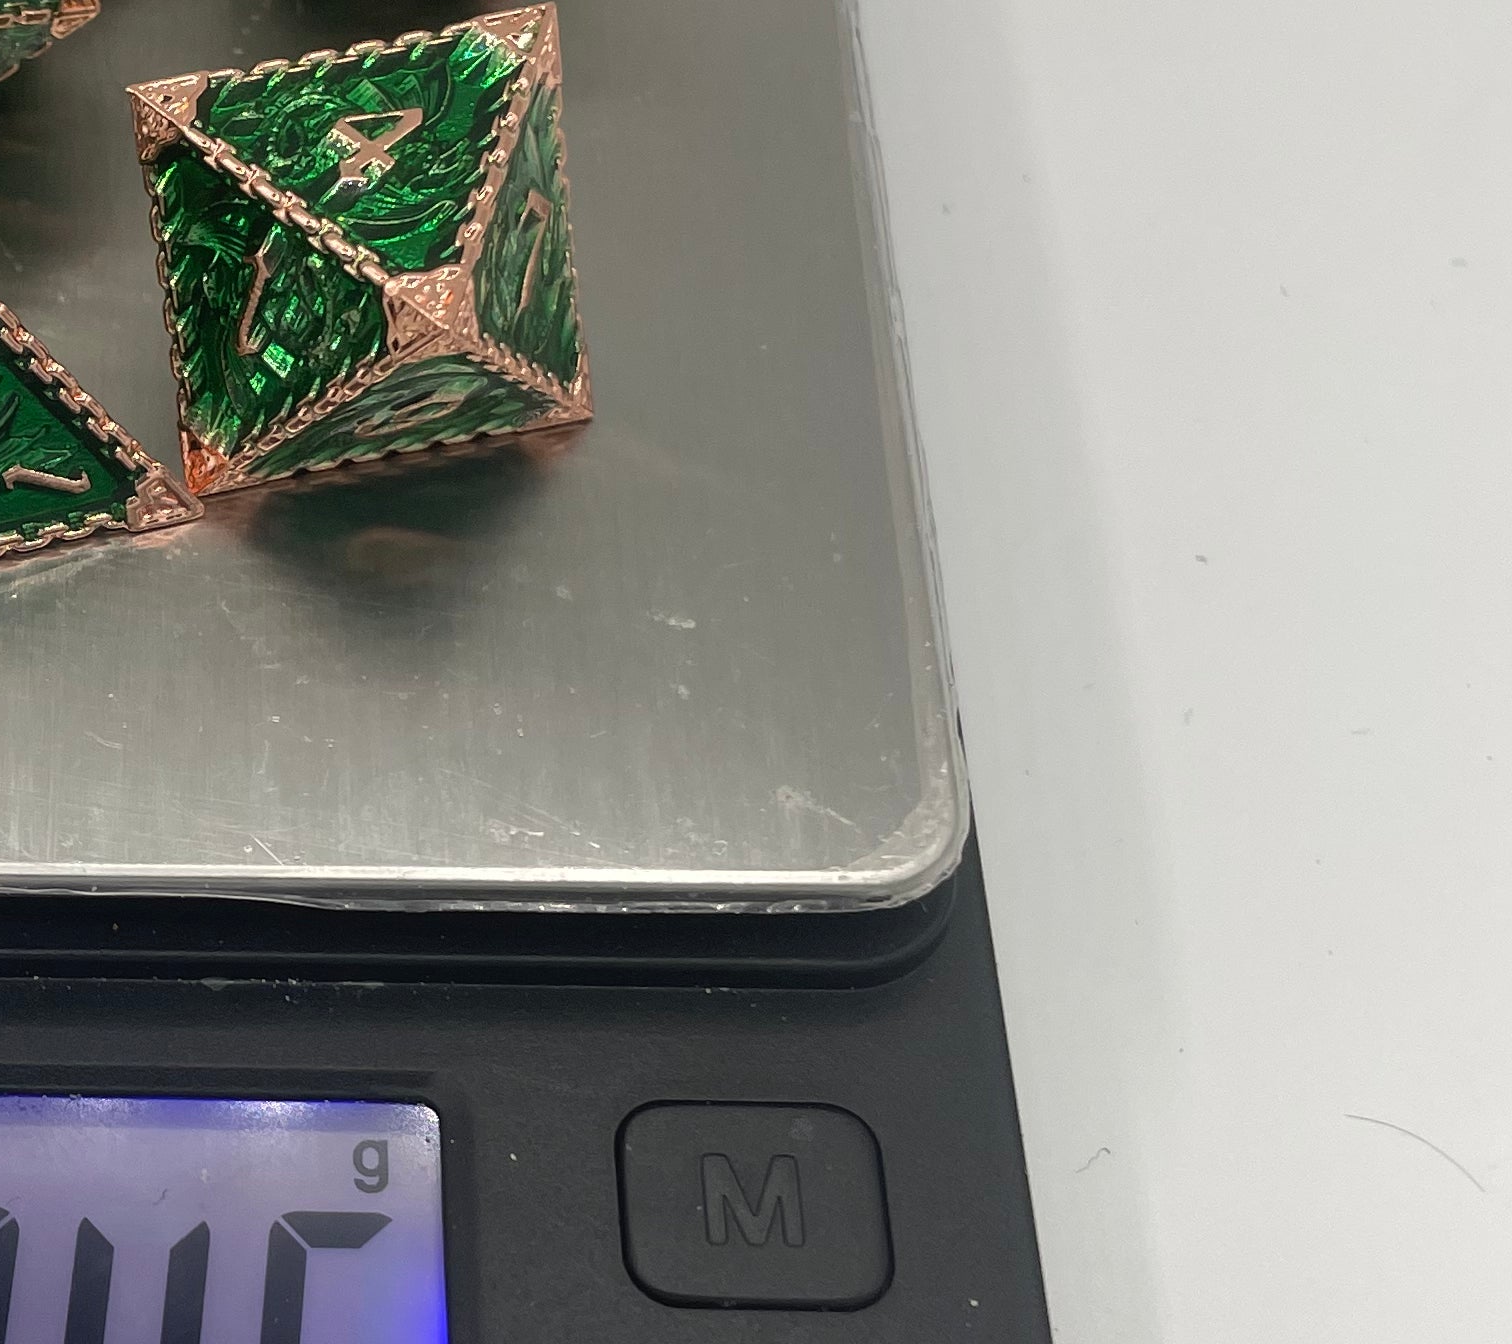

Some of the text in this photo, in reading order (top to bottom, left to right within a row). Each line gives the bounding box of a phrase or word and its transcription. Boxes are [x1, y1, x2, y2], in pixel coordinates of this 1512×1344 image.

[335, 107, 424, 182] 4
[2, 464, 91, 495] 1
[352, 1138, 389, 1194] g
[700, 1153, 805, 1248] M
